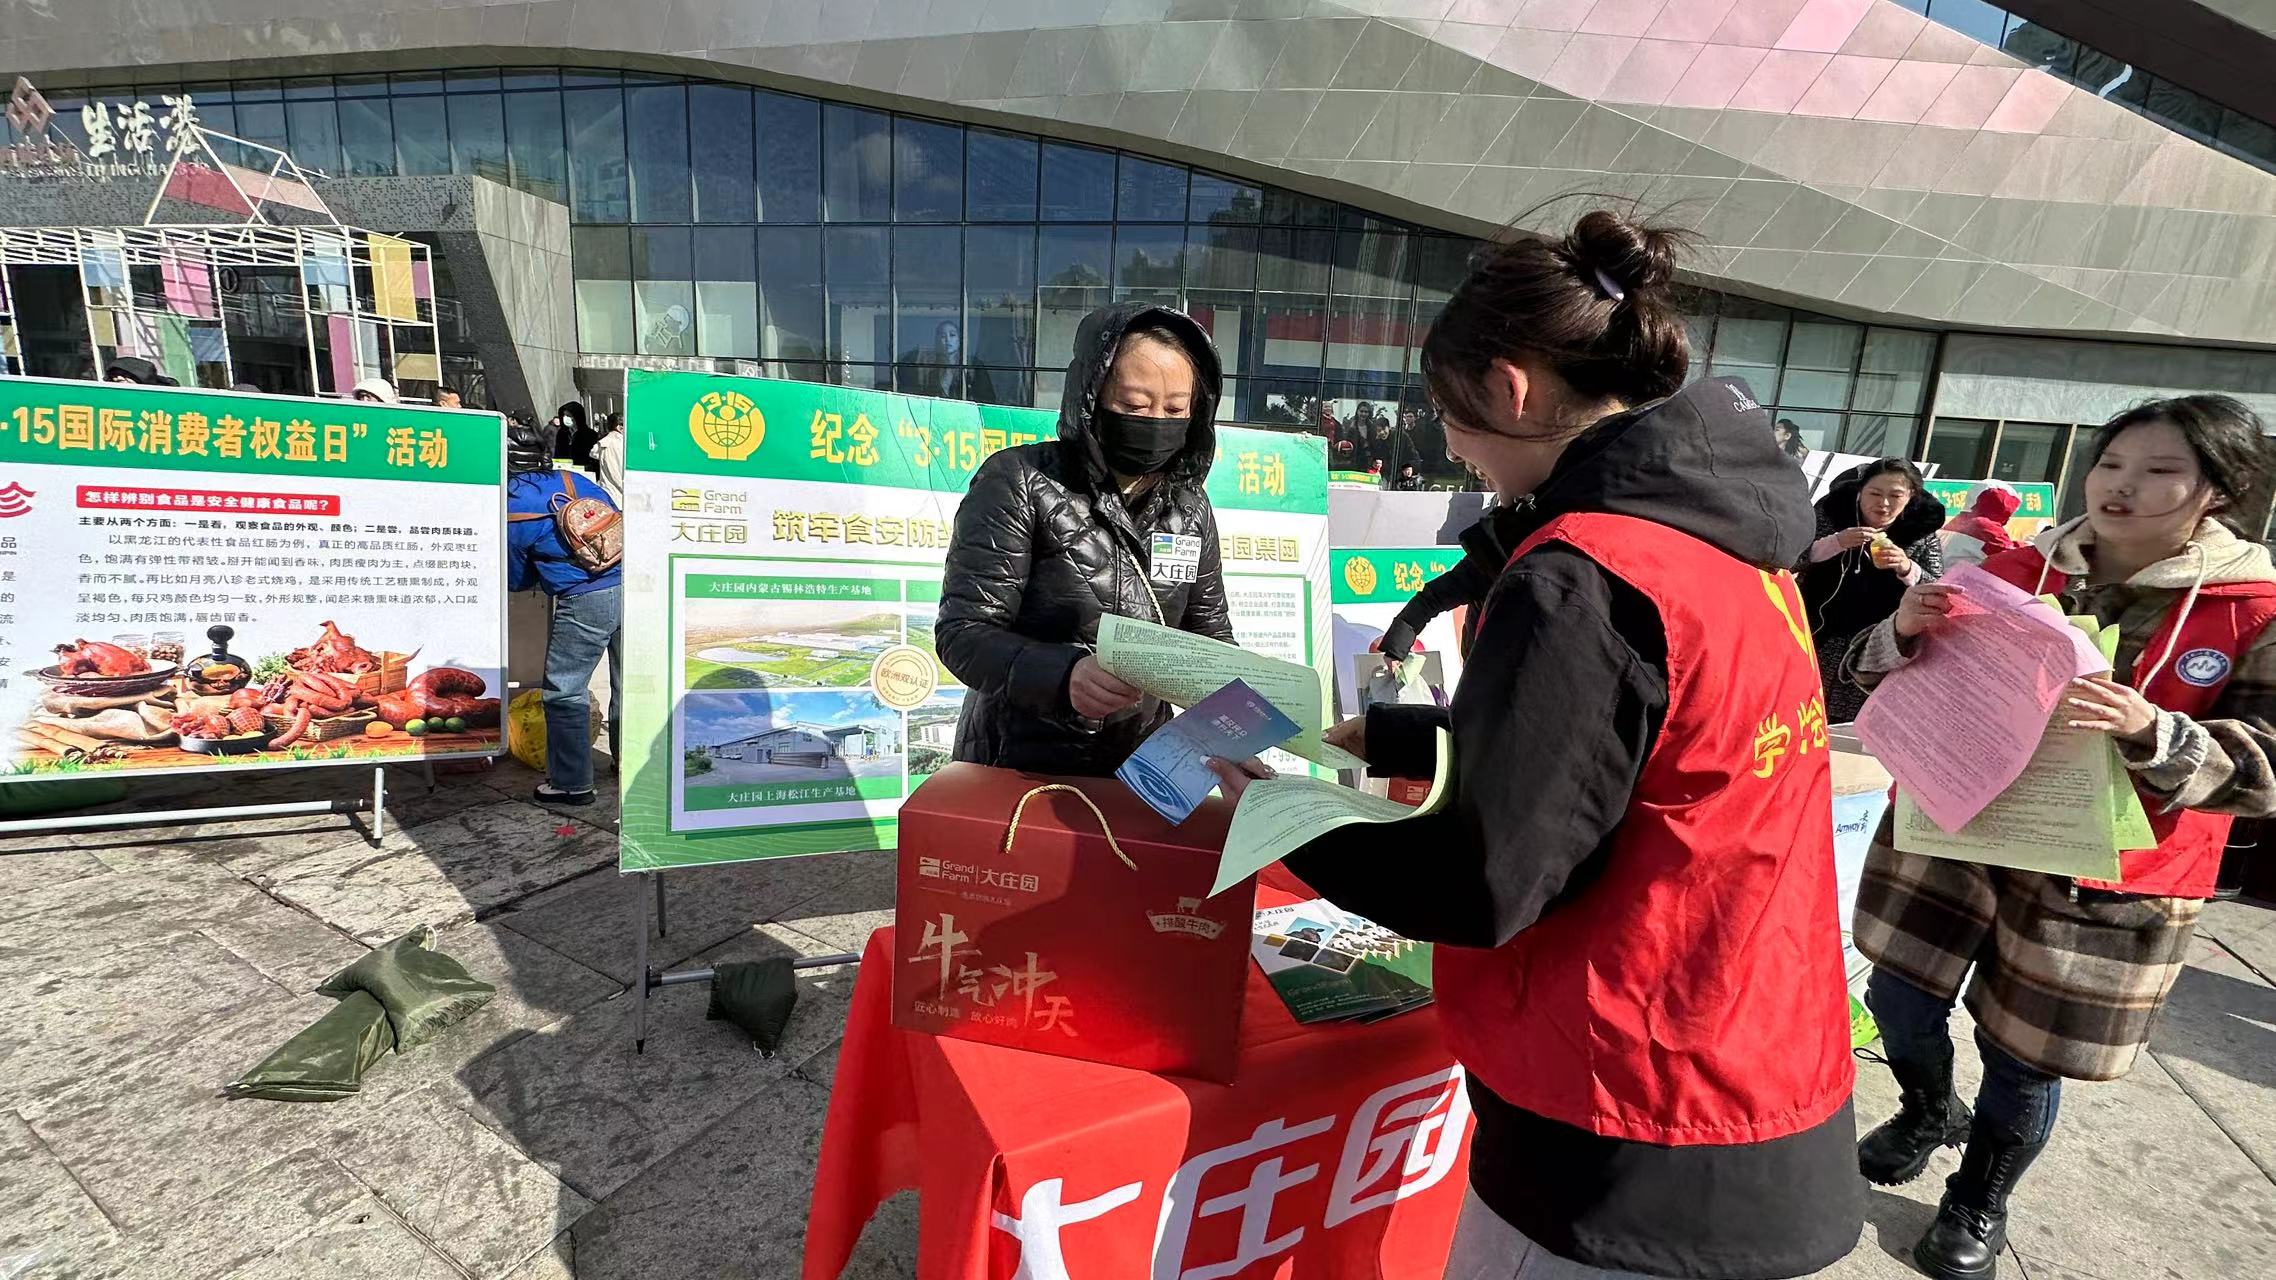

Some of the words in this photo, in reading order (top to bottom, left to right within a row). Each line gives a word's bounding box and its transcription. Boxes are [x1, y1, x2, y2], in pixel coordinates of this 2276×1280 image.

[704, 490, 748, 504] Grand
[704, 502, 743, 515] Farm
[671, 521, 748, 544] 大庄园
[1174, 546, 1197, 557] Farm
[1152, 562, 1198, 581] 大庄园
[1393, 561, 1446, 592] 纪念“
[709, 581, 872, 596] 大庄园内蒙古锡林浩特生产基地
[728, 786, 856, 803] 大庄园上海松江生产基地
[942, 860, 975, 874] Grand
[941, 870, 970, 883] Farm
[980, 868, 1039, 893] 大庄园
